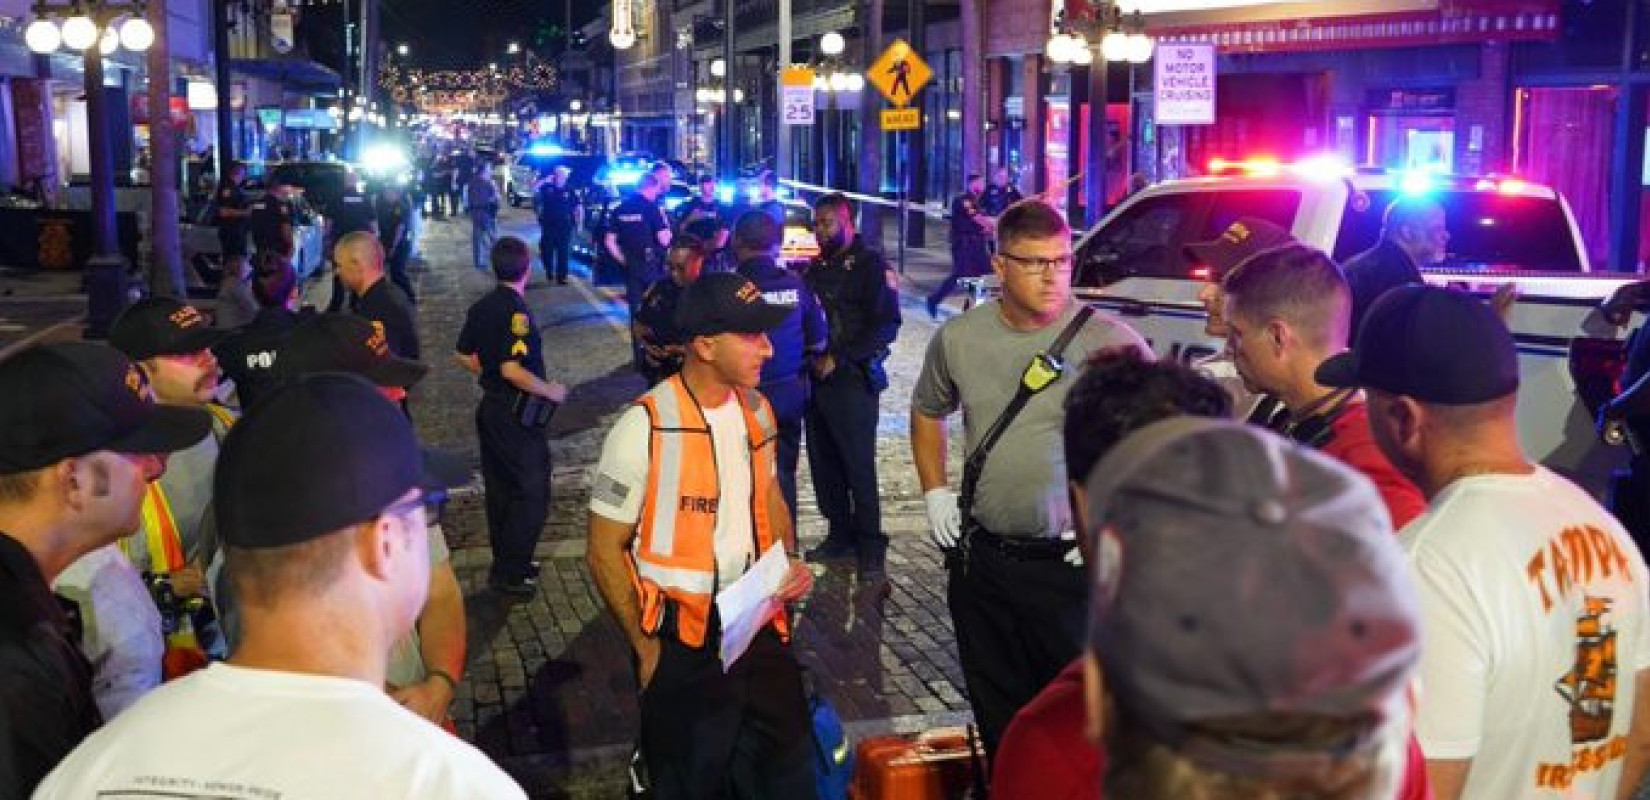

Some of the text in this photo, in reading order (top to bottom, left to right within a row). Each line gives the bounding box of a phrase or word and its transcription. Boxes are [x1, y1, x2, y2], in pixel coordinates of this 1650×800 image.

[1177, 48, 1194, 60] NO
[1165, 62, 1205, 73] MOTOR
[1161, 76, 1208, 88] VEHICLE
[1160, 90, 1210, 102] CRUISING
[786, 104, 811, 120] 25
[680, 495, 719, 513] FIRE
[1527, 524, 1633, 614] TAMPA
